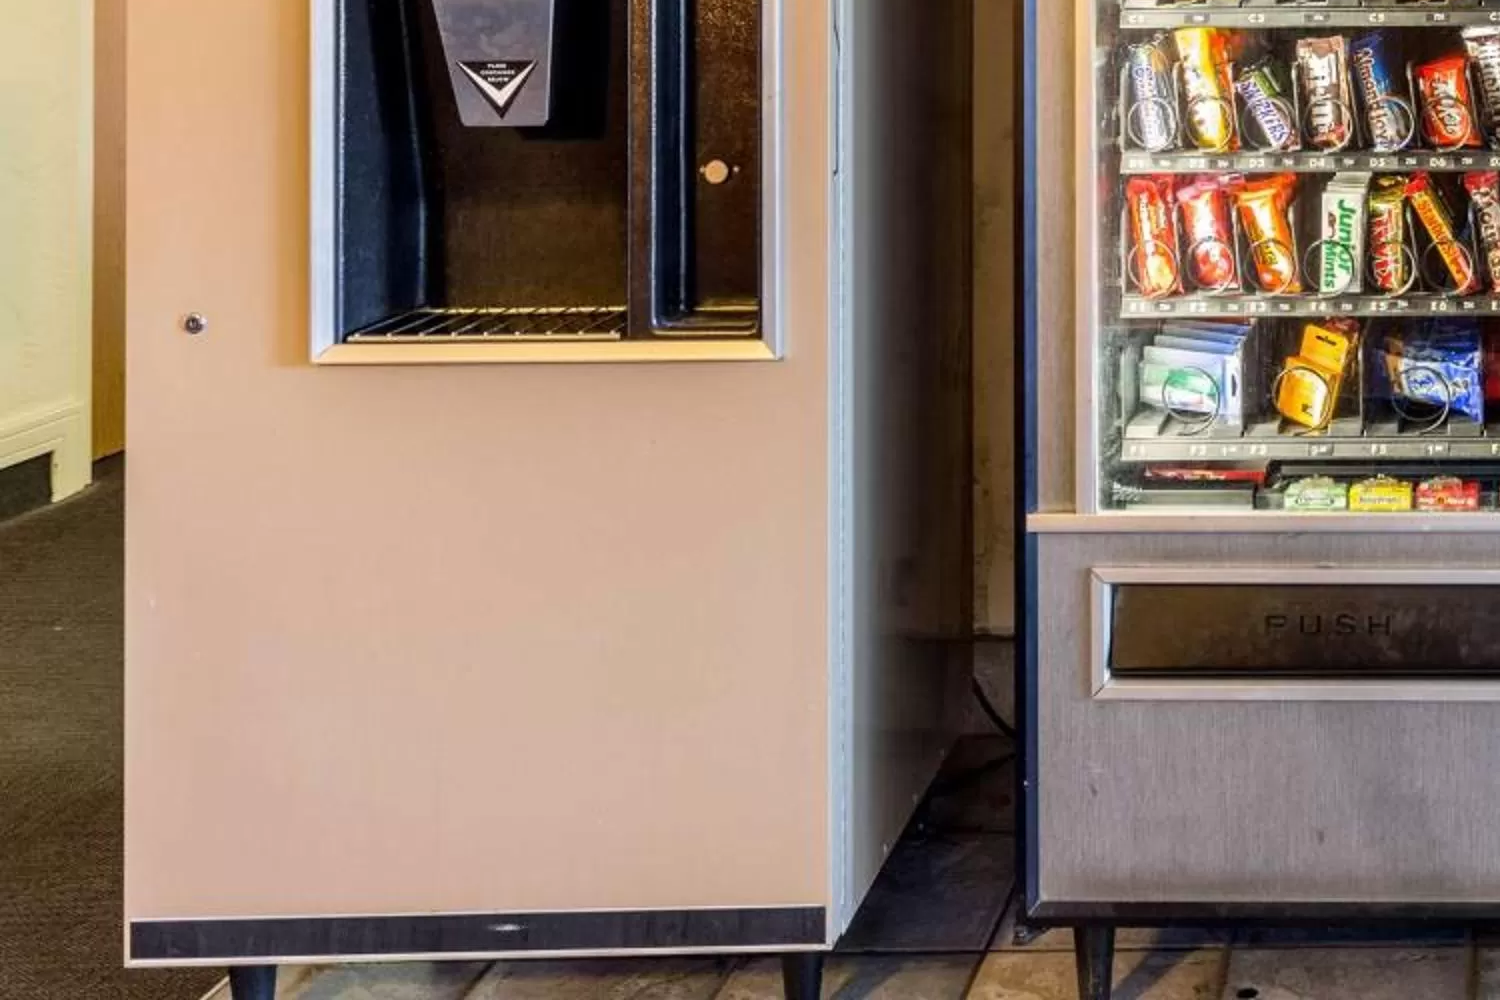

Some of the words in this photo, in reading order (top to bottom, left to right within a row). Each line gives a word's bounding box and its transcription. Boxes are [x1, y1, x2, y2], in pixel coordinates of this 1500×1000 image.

[1236, 81, 1291, 144] SNICKERS
[1323, 239, 1337, 289] Mints
[1337, 199, 1357, 274] Junior
[1264, 613, 1392, 638] PUSH
